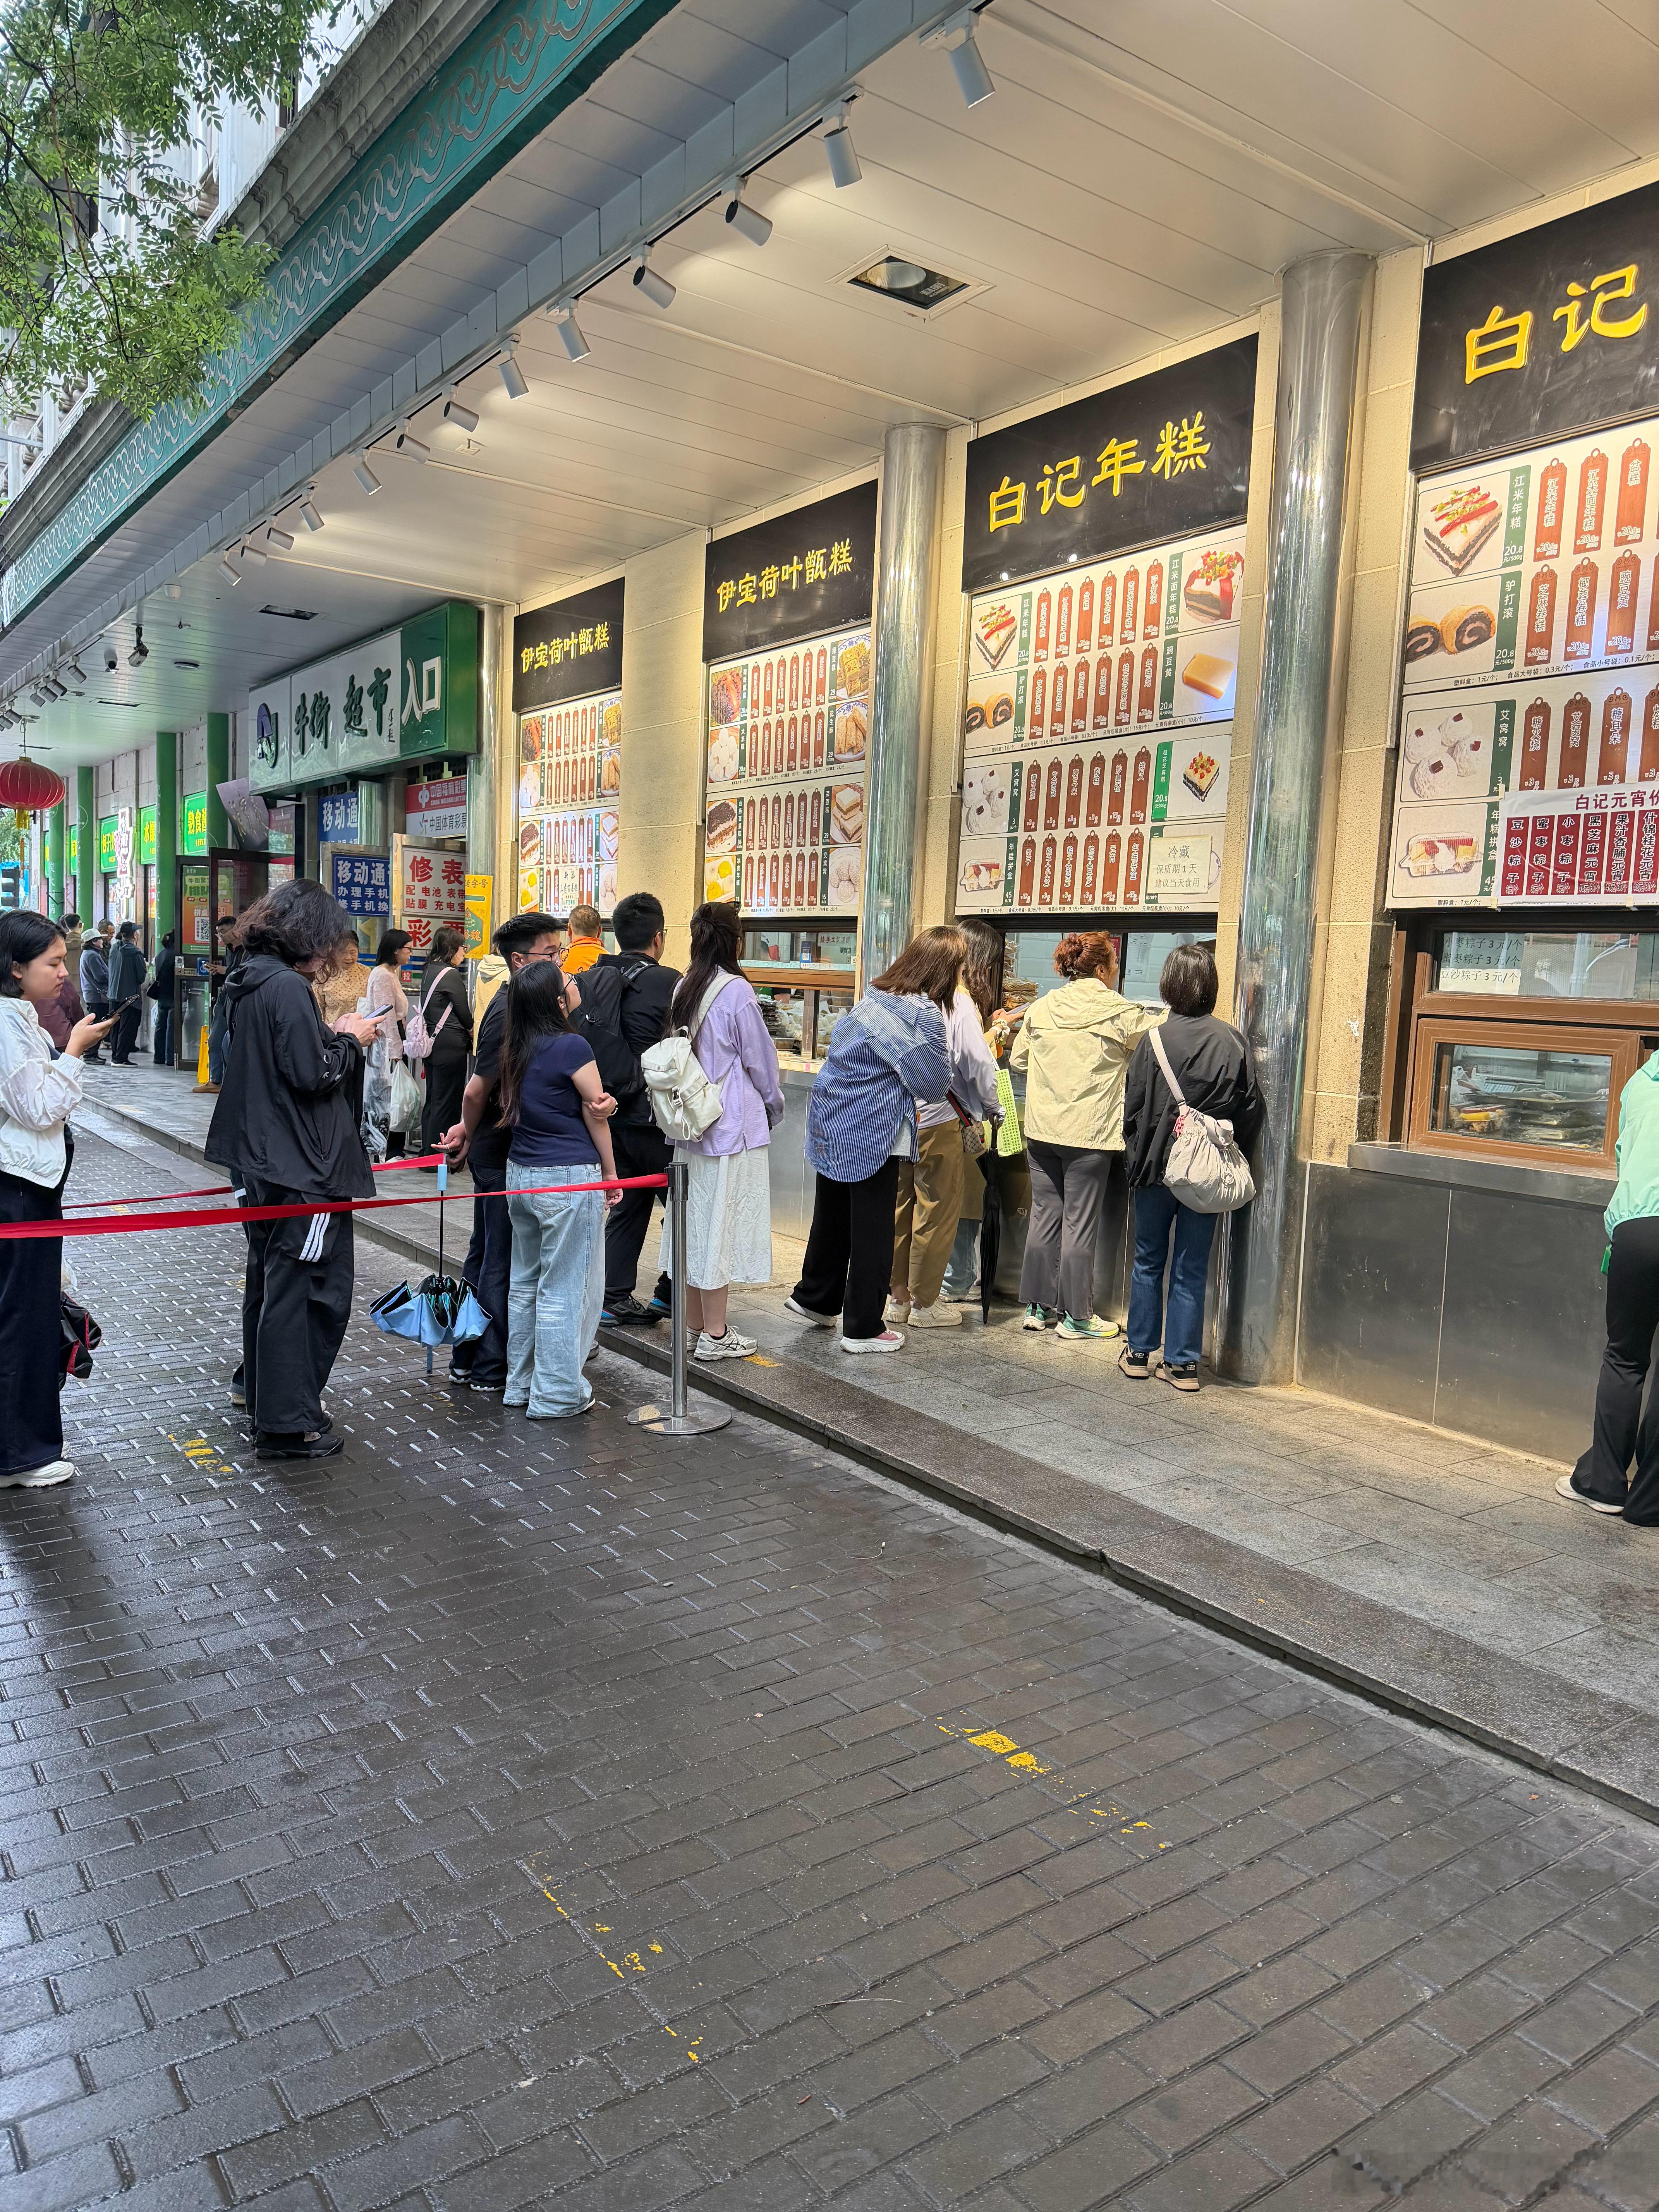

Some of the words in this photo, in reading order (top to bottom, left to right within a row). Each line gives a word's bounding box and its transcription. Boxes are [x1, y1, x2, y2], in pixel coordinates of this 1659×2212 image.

[1466, 264, 1647, 384] 白记
[989, 411, 1211, 532] 白记年糕
[1627, 459, 1642, 486] 盆糕
[1510, 475, 1525, 529] 江米年糕
[1544, 478, 1559, 527] 江米年糕
[1583, 469, 1600, 531] 江米面年糕
[1503, 555, 1523, 563] 元/500g
[1504, 545, 1523, 556] 20.8
[717, 538, 853, 613] 伊宝荷叶甑糕
[1169, 560, 1179, 614] 江米面年糕
[1617, 570, 1632, 609] 豌豆黄
[1503, 579, 1516, 619] 驴打滚
[1534, 584, 1549, 633] 芝麻卷糕
[1575, 577, 1590, 627] 椰蓉卷糕
[1166, 616, 1178, 625] 20.8
[521, 622, 609, 673] 伊宝荷叶甑糕
[1165, 646, 1173, 677] 豌豆黄
[1496, 650, 1514, 659] 20.8
[401, 656, 440, 725] 入口
[1160, 702, 1173, 711] 20.8
[1498, 709, 1510, 747] 艾窝窝
[1529, 716, 1543, 751] 糖火烧
[1569, 711, 1582, 748] 艾窝窝
[1609, 707, 1624, 745] 糖耳朵
[430, 779, 466, 797] 中国福利彩票
[1155, 794, 1168, 802] 20.8
[1497, 776, 1502, 785] 3
[323, 797, 358, 832] 移动通
[430, 813, 466, 831] 中国体育彩票
[1168, 845, 1190, 859] 冷藏
[1506, 819, 1523, 884] 豆沙粽子
[1532, 817, 1549, 883] 蜜枣粽子
[1557, 817, 1575, 882] 小枣粽子
[1584, 815, 1601, 881] 黑芝麻元宵
[1611, 813, 1629, 881] 果汁杏脯元宵
[1639, 812, 1659, 881] 什锦桂花元宵
[337, 860, 390, 886] 移动通
[409, 855, 464, 885] 修表
[1155, 878, 1200, 888] 建议当天食用
[338, 886, 389, 899] 办理手机
[406, 884, 415, 895] 配
[421, 886, 441, 897] 电池
[447, 888, 465, 899] 表带
[406, 898, 427, 909] 贴膜
[434, 900, 465, 912] 充电宝
[403, 972, 411, 981] 拉
